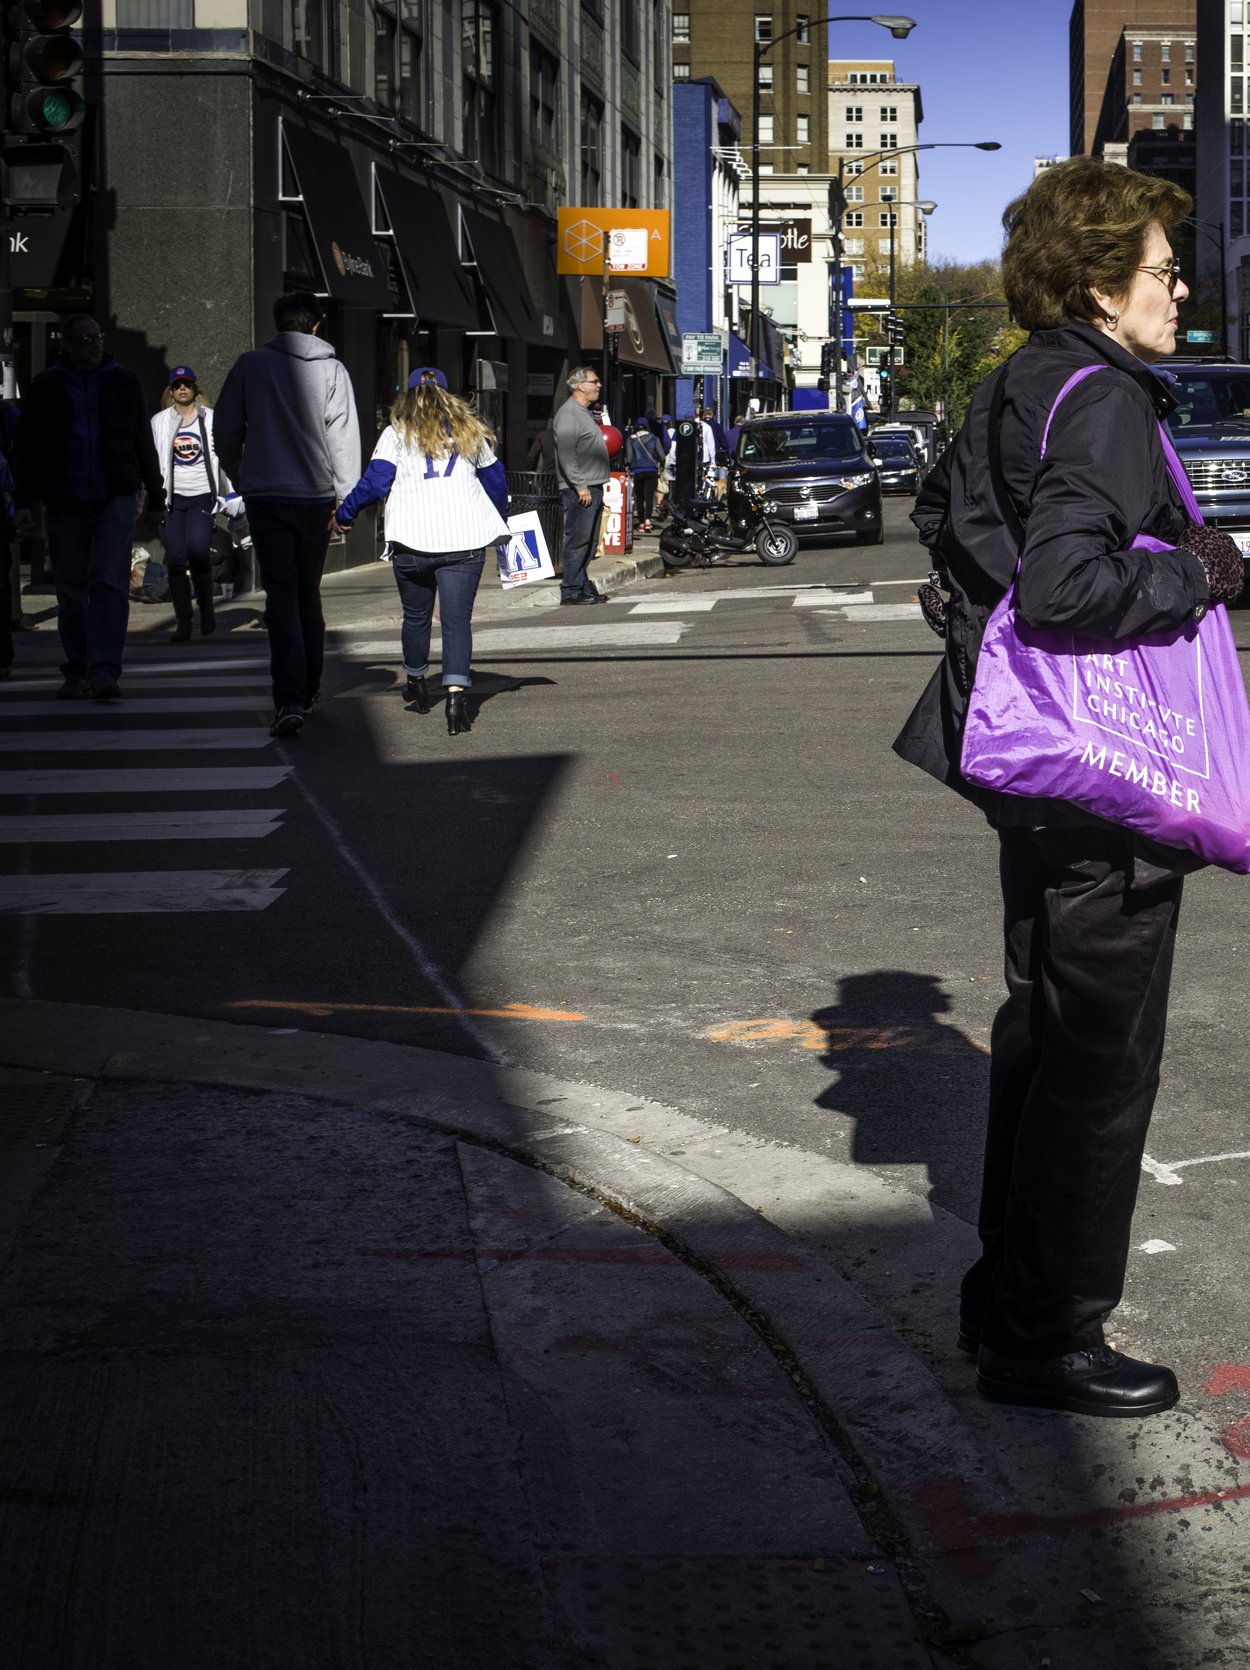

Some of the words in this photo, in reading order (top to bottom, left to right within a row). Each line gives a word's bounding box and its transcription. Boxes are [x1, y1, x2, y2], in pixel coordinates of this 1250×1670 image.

[735, 248, 771, 268] Tea
[1085, 653, 1129, 677] ART
[1087, 694, 1185, 754] CHICAGO
[1080, 740, 1201, 814] MEMBER
